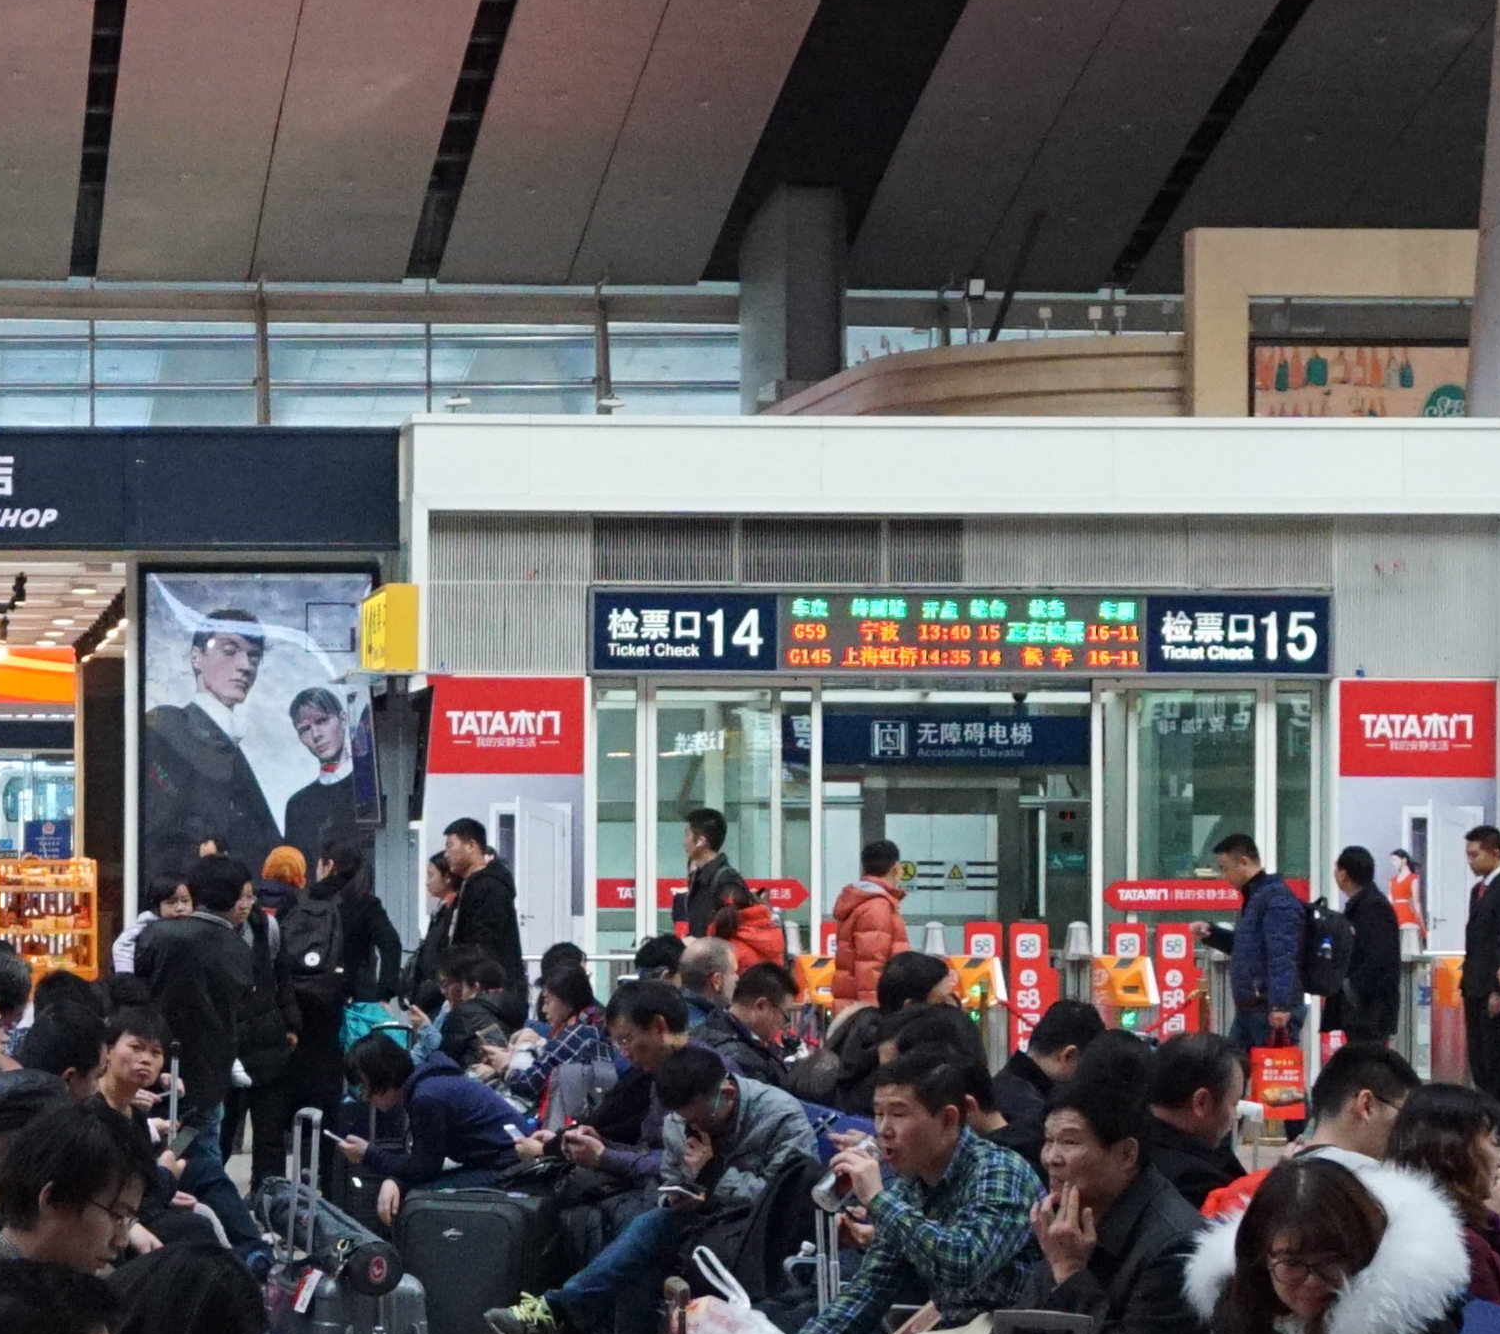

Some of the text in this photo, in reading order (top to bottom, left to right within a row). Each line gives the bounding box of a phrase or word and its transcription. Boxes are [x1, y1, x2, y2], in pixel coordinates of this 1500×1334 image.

[607, 607, 764, 658] 检票口 14
[793, 621, 1139, 643] G59 宁波 13:40 15 正在检票 16-11
[1161, 611, 1317, 662] 检票口 15
[608, 642, 701, 658] Ticket Check
[789, 648, 832, 665] G145
[840, 646, 918, 667] 上海虹桥
[918, 649, 972, 665] 14:35
[978, 649, 1001, 665] 14
[1087, 649, 1140, 666] 16-11
[1162, 645, 1254, 661] Ticket Check
[445, 709, 561, 737] TATA木门
[1359, 713, 1474, 740] TATA木门
[916, 722, 1033, 746] 无障碍电梯
[1118, 887, 1169, 902] TATA木门
[974, 937, 992, 954] 58
[1019, 937, 1037, 954] 58
[1119, 937, 1137, 954] 58
[1165, 937, 1183, 954] 58
[1017, 990, 1040, 1009] 58
